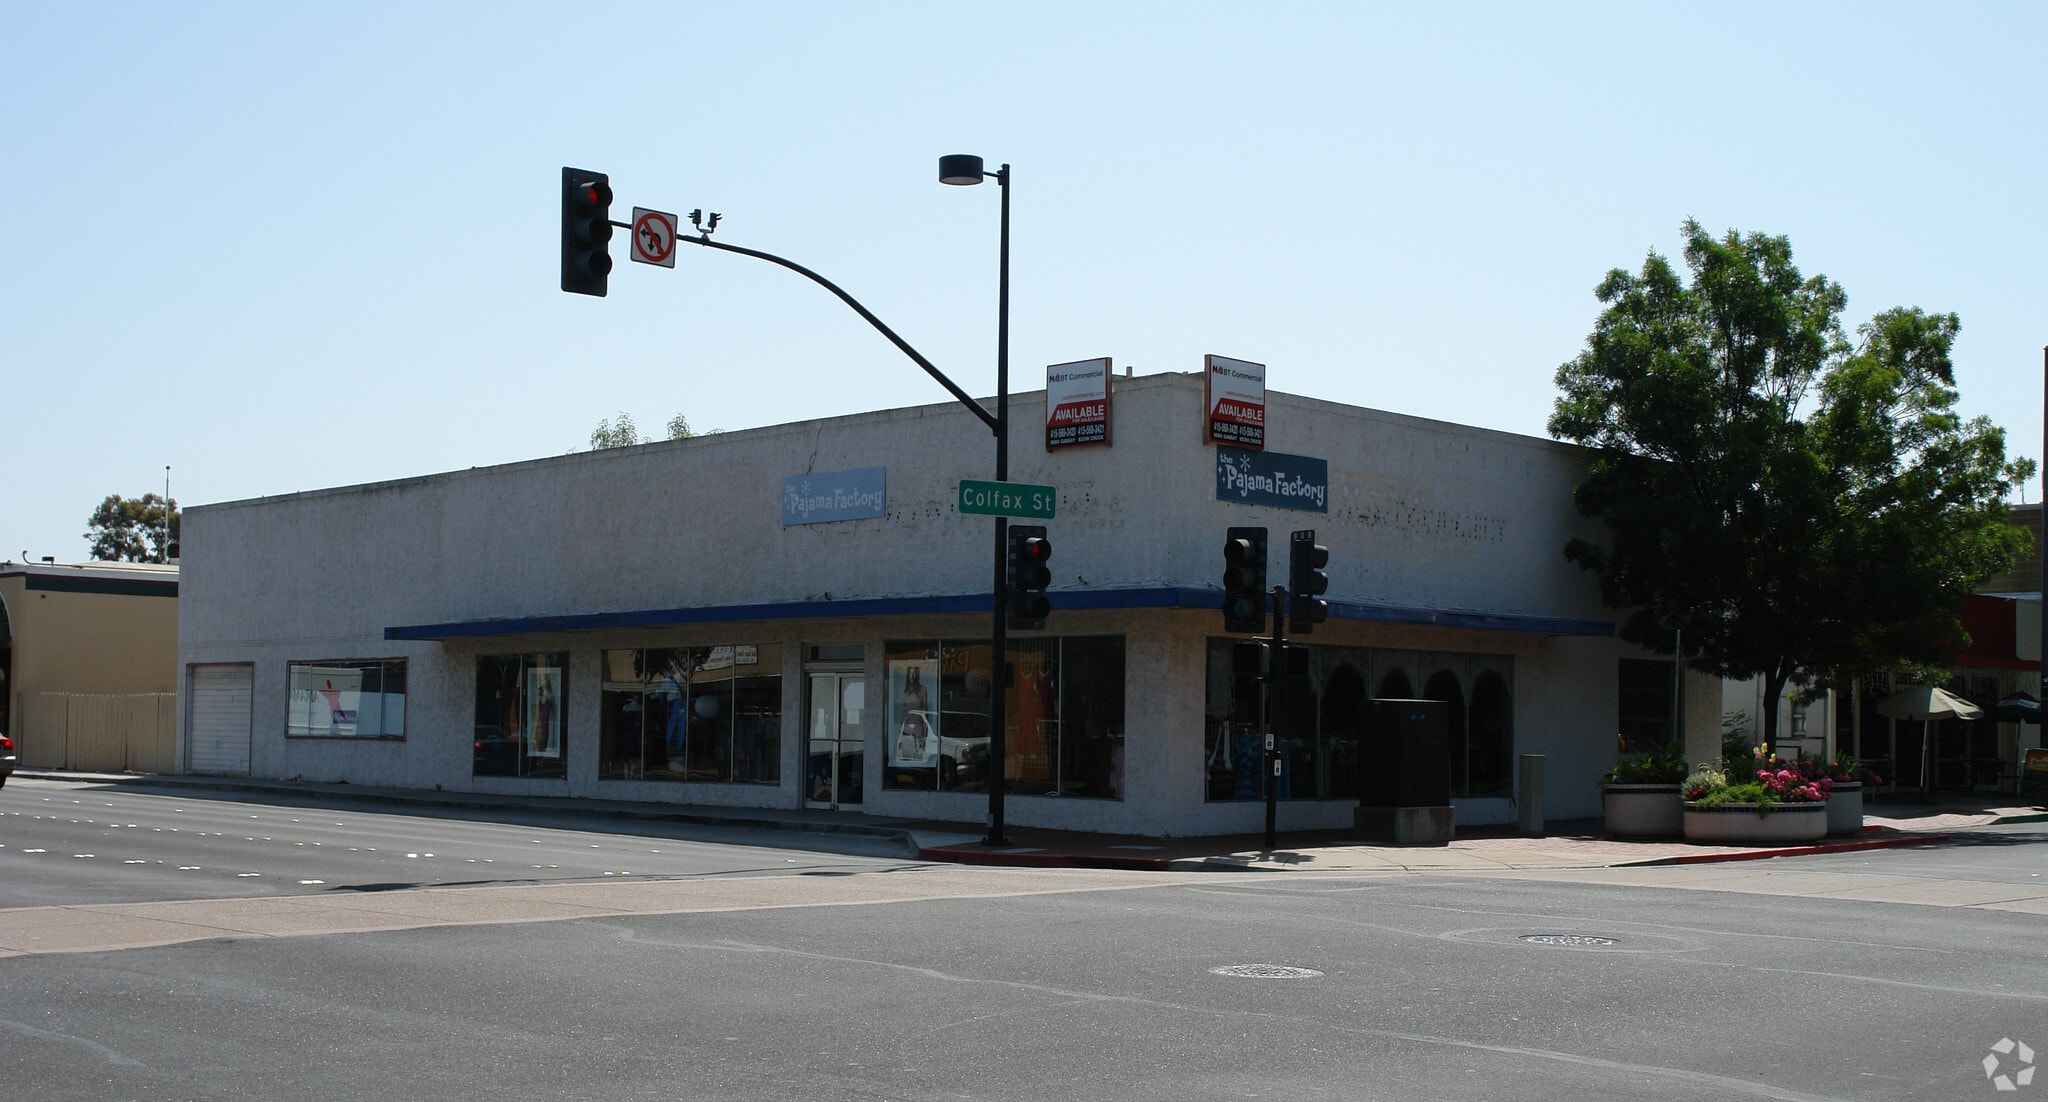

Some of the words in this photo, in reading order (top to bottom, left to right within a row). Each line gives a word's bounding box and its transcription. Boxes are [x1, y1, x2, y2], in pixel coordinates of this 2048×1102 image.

[1061, 374, 1068, 382] BT
[1069, 370, 1103, 380] Commercial
[1232, 371, 1262, 382] Commercial
[1056, 405, 1104, 420] AVAILABLE
[1219, 404, 1263, 420] AVAILABLE
[1220, 454, 1233, 464] the
[786, 484, 796, 492] the
[1225, 464, 1273, 497] Pajama
[1274, 472, 1325, 506] Factory
[790, 493, 832, 518] Pajama
[834, 487, 882, 512] Factory
[963, 488, 1022, 509] Colfax
[1033, 493, 1051, 511] St
